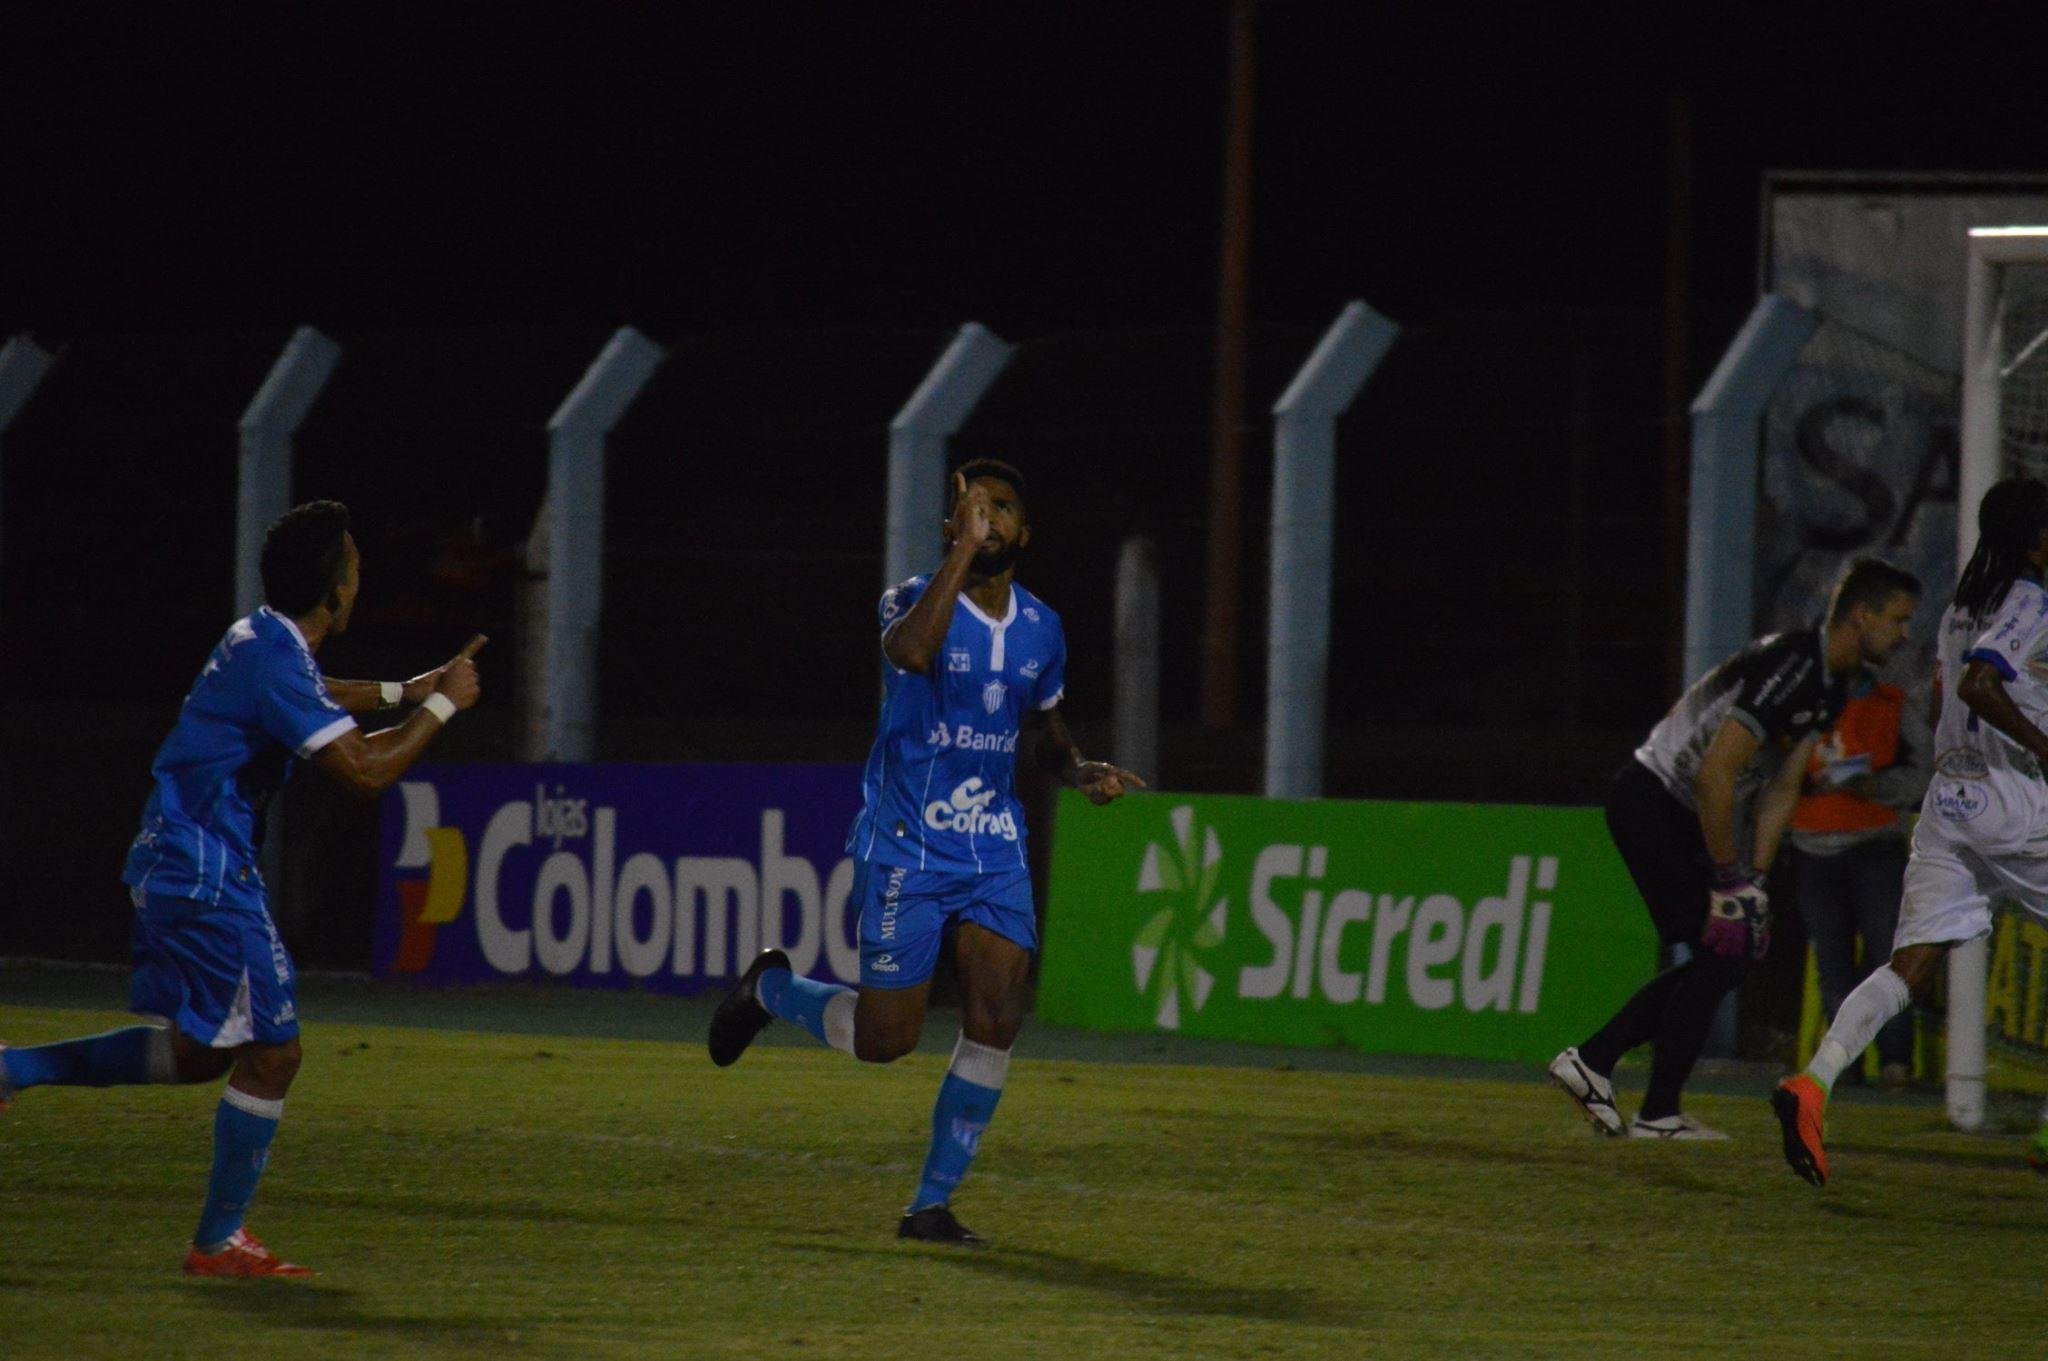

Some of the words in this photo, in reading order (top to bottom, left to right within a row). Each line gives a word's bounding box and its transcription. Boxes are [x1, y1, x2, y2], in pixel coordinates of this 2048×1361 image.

[535, 783, 588, 849] lojas
[880, 867, 907, 940] MULTSOM
[1238, 843, 1560, 1014] Sicredi
